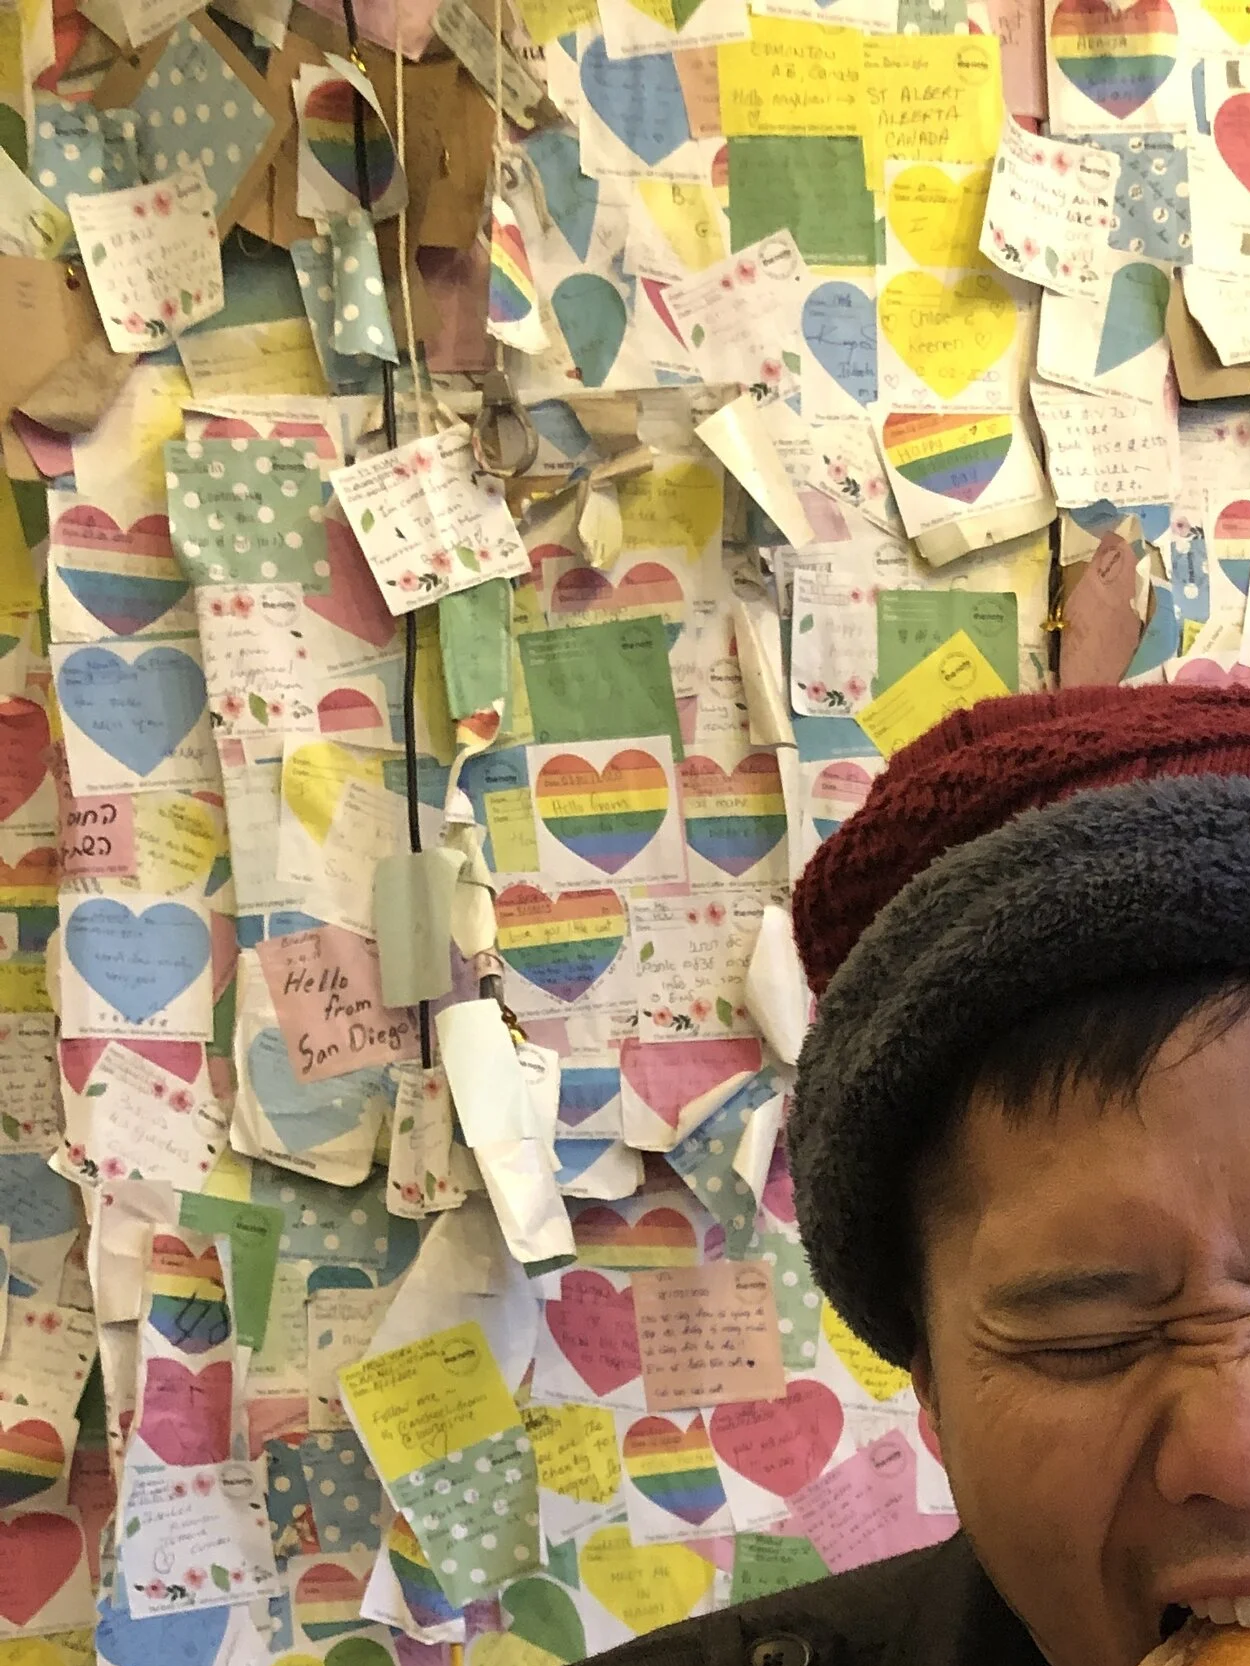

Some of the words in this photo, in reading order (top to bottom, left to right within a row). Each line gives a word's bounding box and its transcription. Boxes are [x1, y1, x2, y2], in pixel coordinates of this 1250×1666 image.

[284, 966, 349, 995] Hello
[324, 993, 372, 1021] from
[299, 1033, 339, 1075] San
